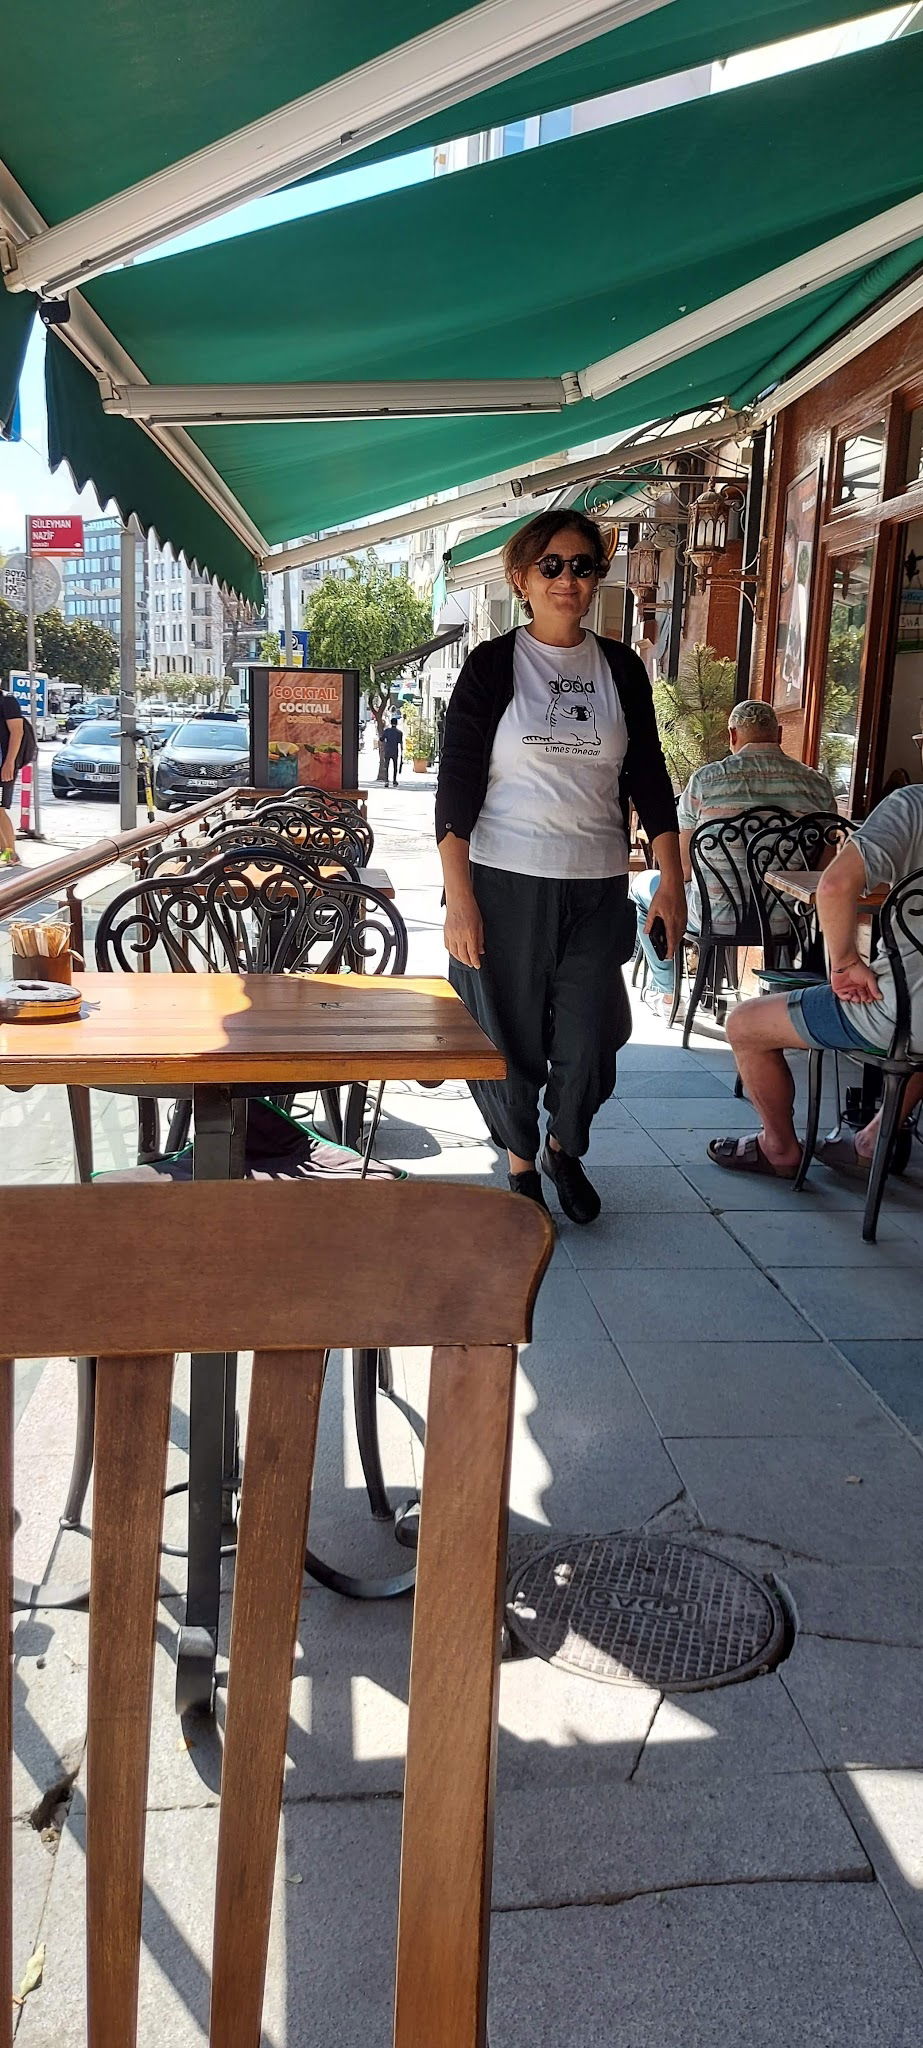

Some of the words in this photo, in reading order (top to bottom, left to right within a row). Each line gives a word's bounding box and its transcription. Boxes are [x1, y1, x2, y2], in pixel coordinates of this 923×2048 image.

[273, 686, 339, 700] COCKTAIL
[279, 702, 332, 713] COCKTAIL
[545, 745, 570, 753] times
